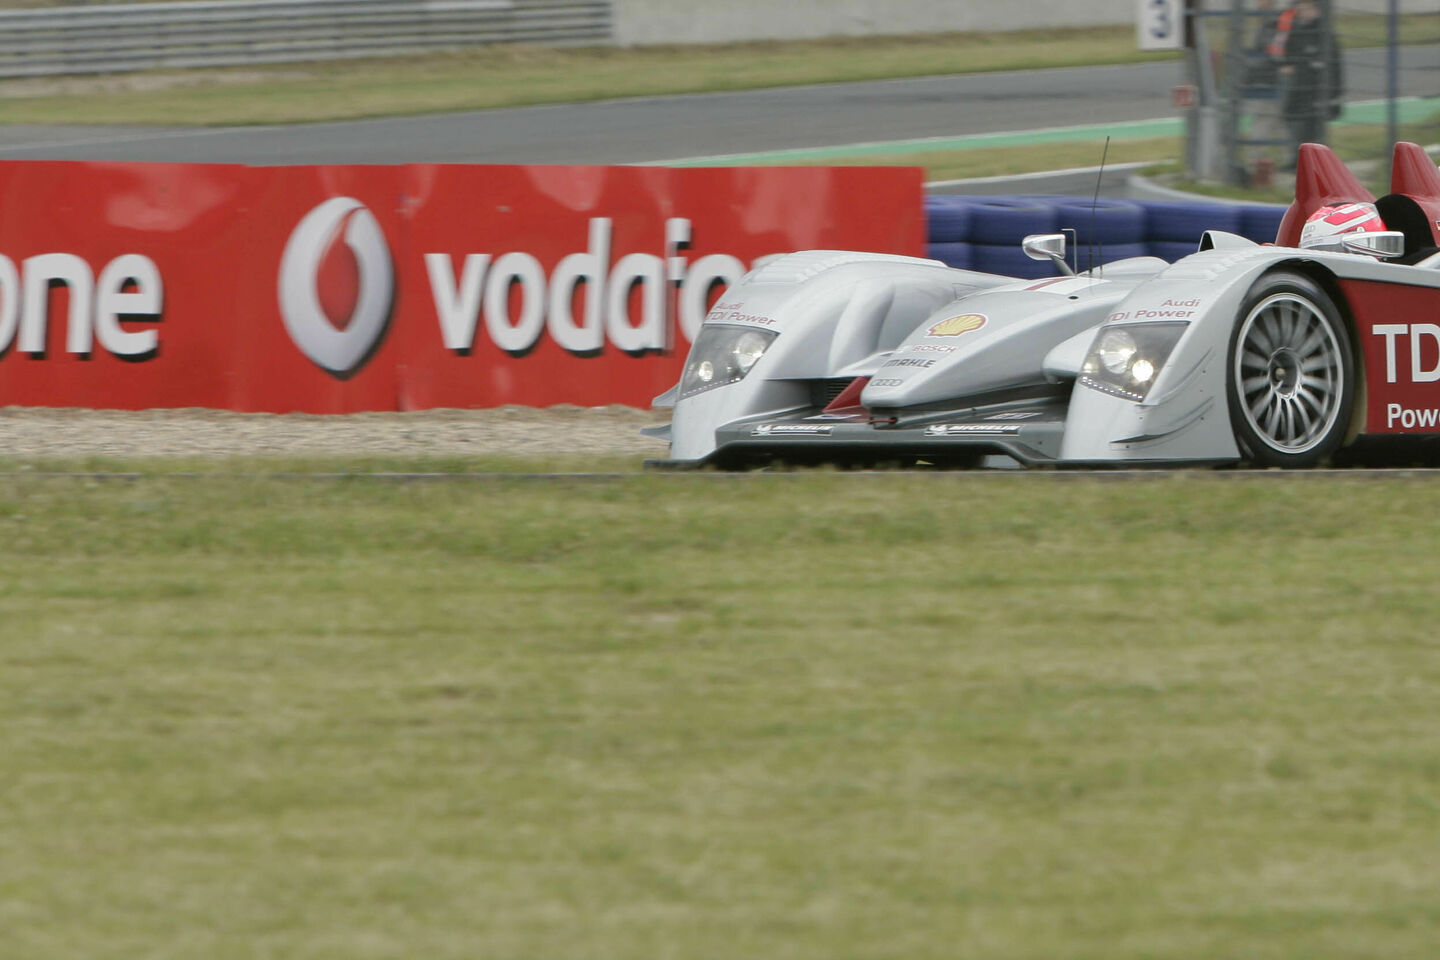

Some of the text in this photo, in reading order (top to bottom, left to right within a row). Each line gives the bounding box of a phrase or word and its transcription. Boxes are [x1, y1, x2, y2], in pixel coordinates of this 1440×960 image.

[1161, 299, 1201, 308] Audi
[728, 311, 777, 326] Power
[1134, 309, 1196, 320] Power
[912, 344, 958, 353] BOSCH
[882, 358, 937, 368] MAHLE
